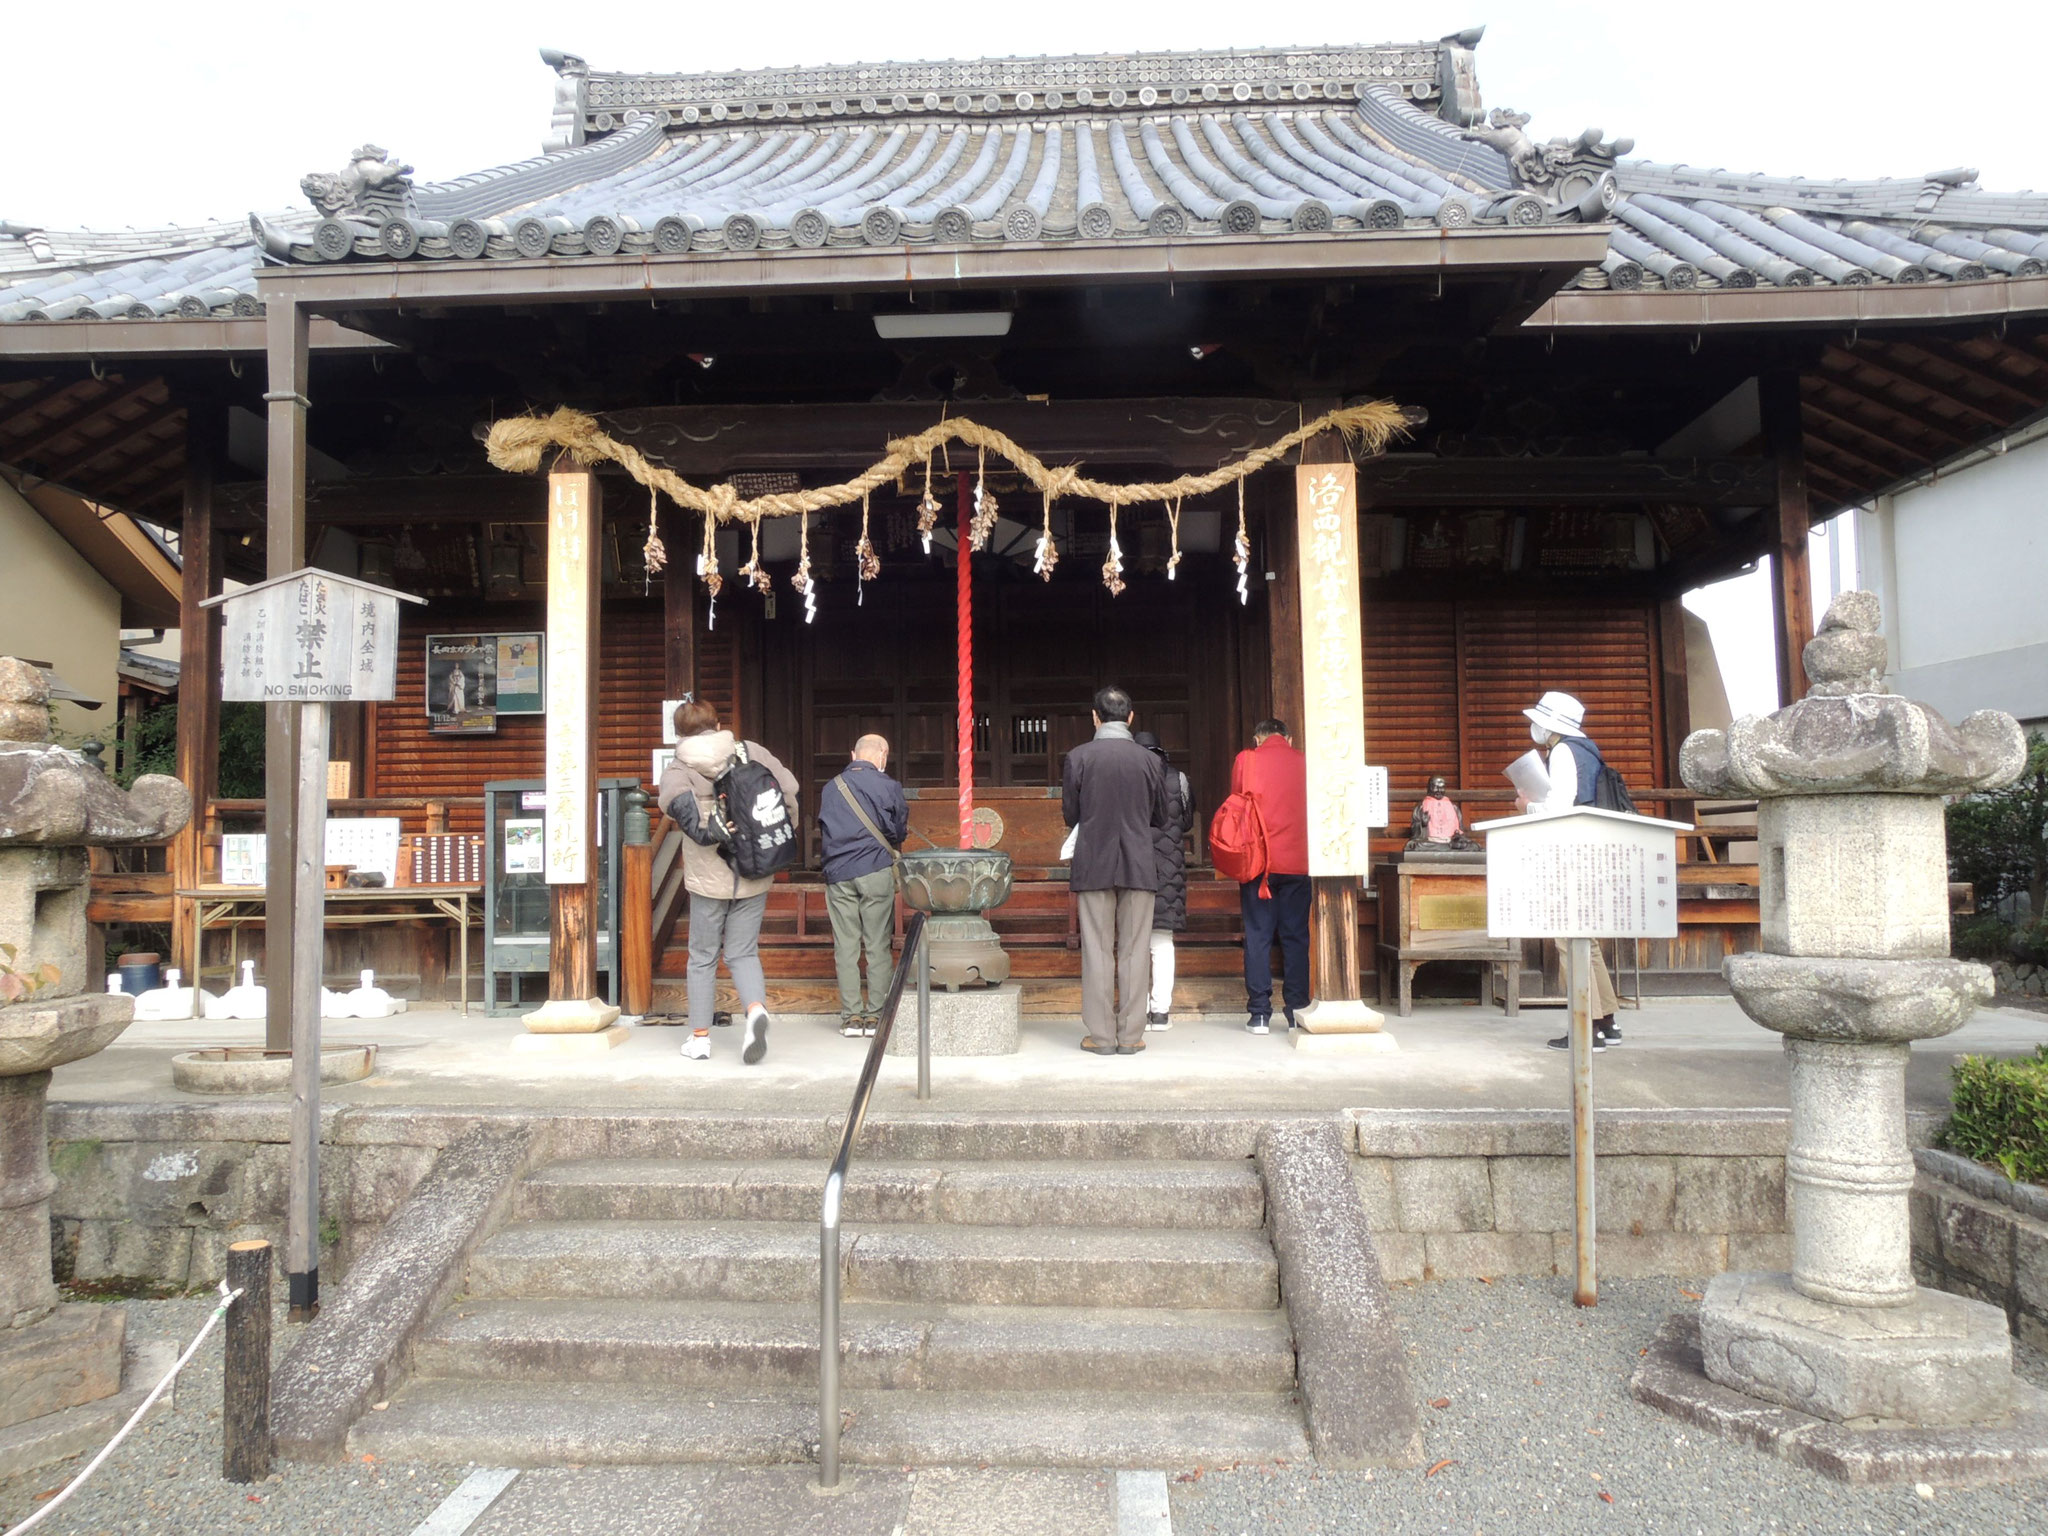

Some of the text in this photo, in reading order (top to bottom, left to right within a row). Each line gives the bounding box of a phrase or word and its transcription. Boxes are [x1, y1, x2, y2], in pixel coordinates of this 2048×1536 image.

[299, 580, 309, 615] たばこ
[293, 619, 327, 680] 禁止
[359, 600, 376, 673] 境内全域
[264, 684, 353, 696] NO SMOKING
